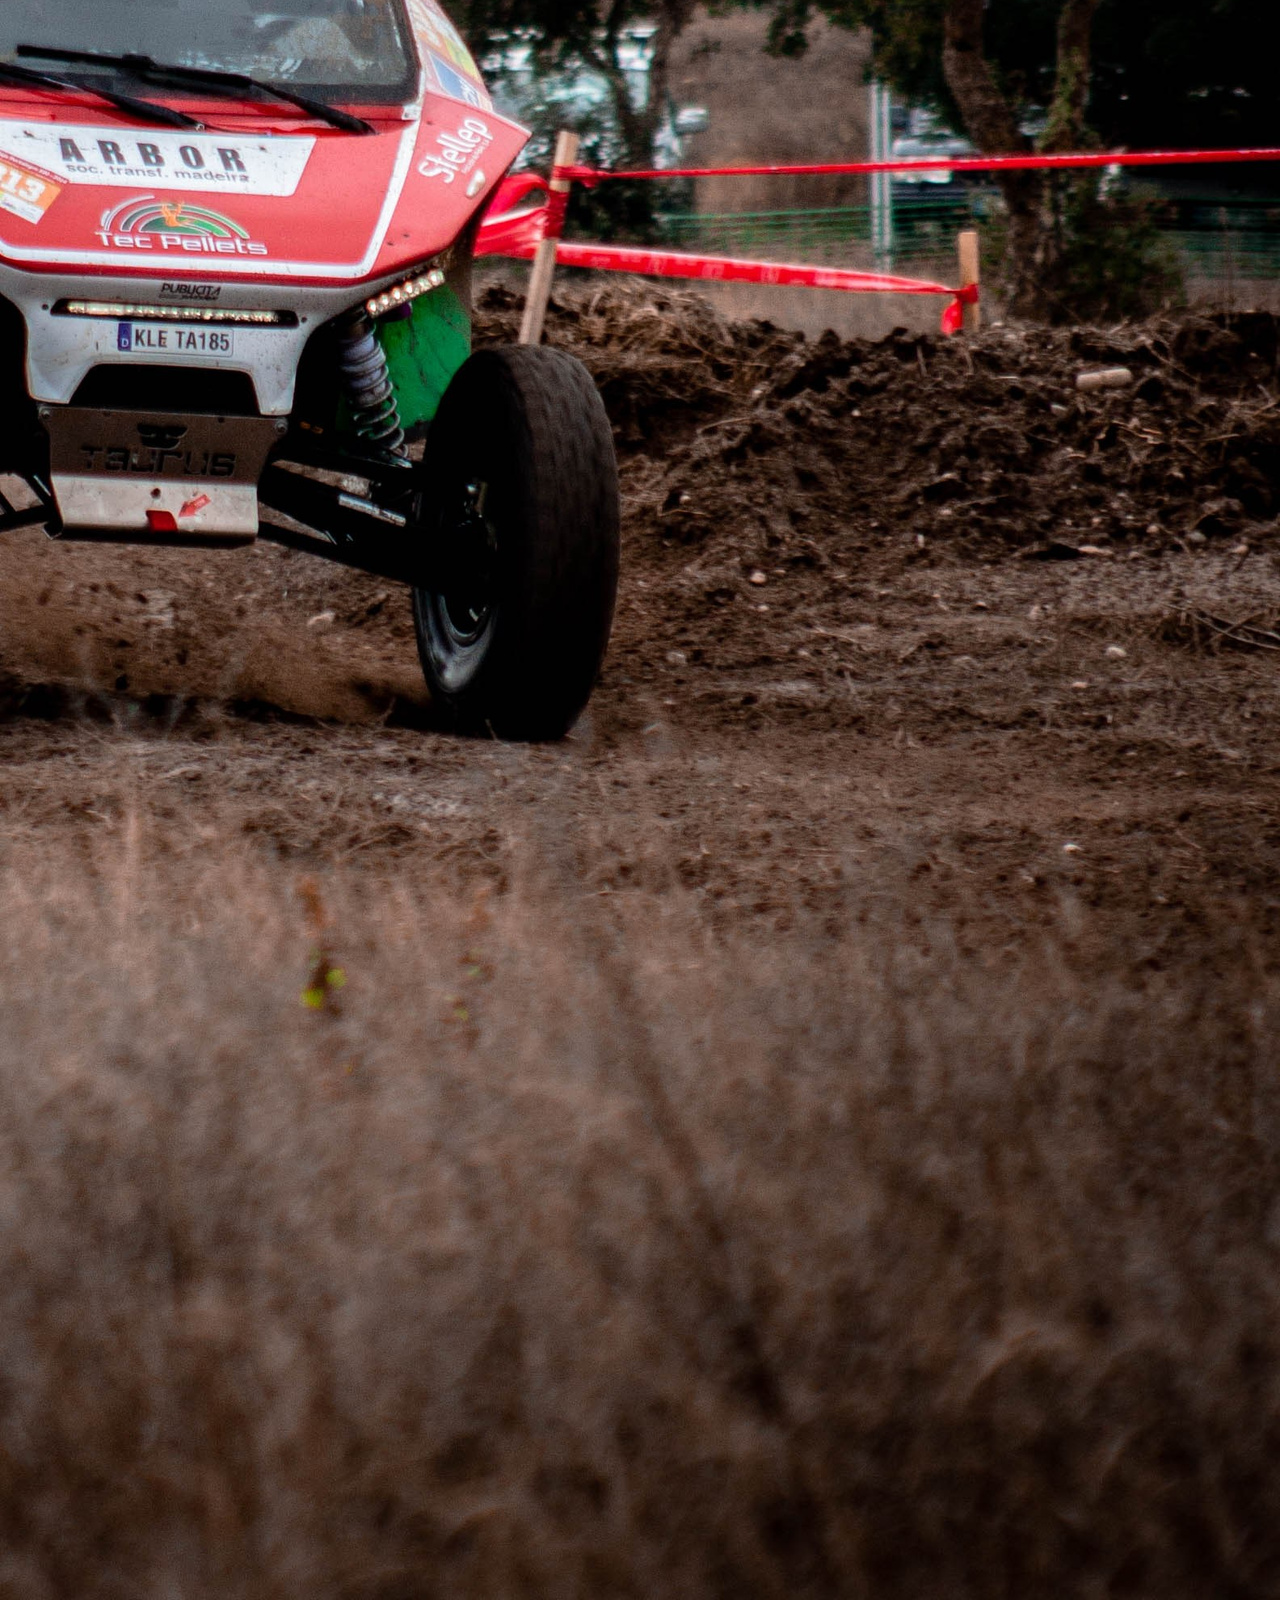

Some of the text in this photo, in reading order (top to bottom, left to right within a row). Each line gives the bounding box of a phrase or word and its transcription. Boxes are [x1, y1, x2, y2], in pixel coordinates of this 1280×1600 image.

[59, 137, 247, 174] ARBOR
[419, 117, 493, 184] Stellep
[66, 163, 103, 174] soc.
[94, 230, 268, 255] Tec Pellets
[134, 328, 230, 352] KLE TA185
